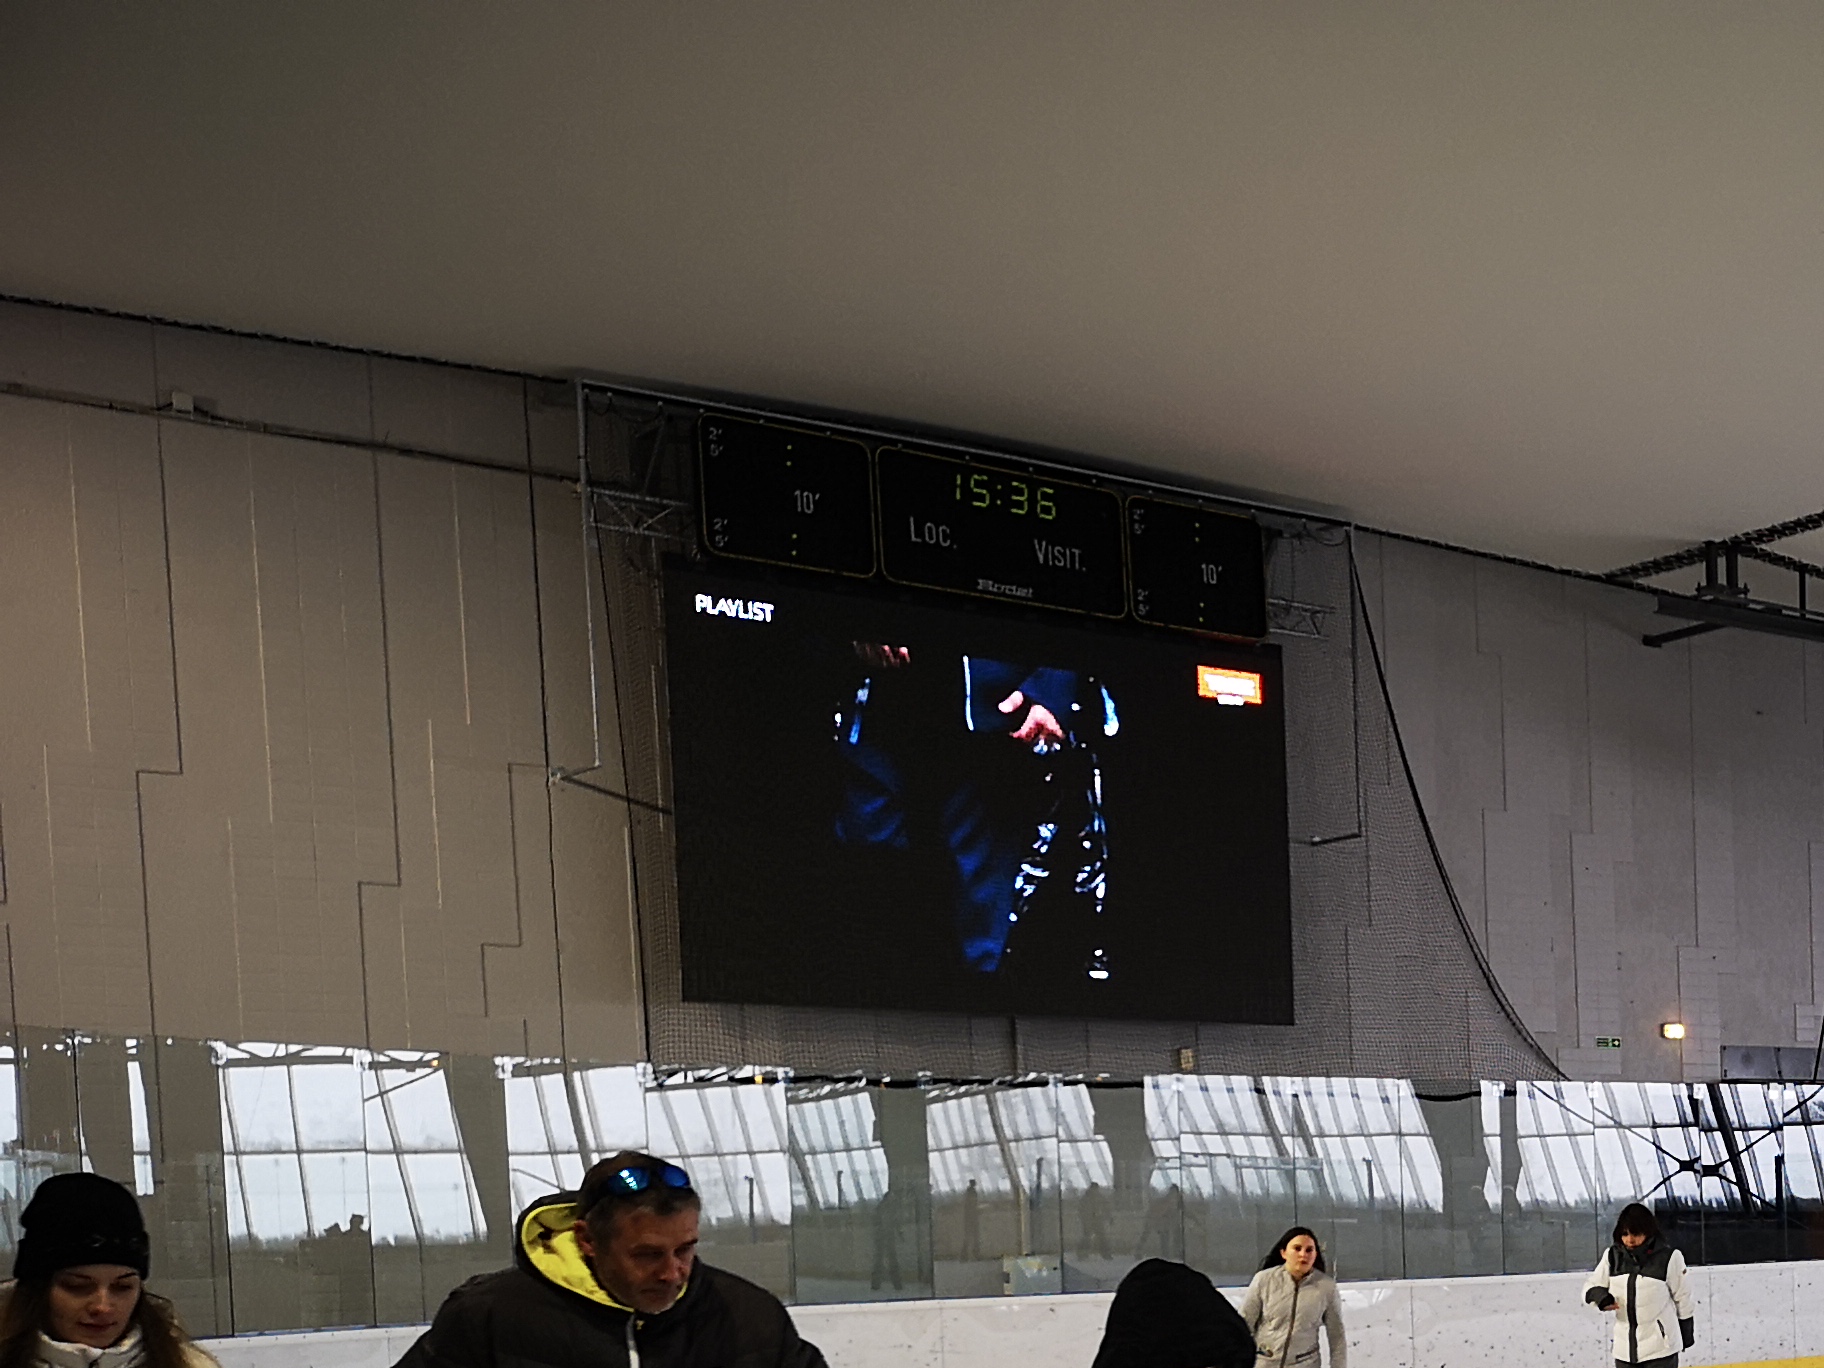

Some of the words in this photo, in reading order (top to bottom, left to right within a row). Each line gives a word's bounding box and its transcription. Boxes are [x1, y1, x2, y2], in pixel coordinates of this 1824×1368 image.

[793, 488, 821, 514] 10'
[955, 473, 1057, 521] 15:36
[1200, 563, 1223, 585] 10'
[695, 593, 775, 623] PLAYLIST
